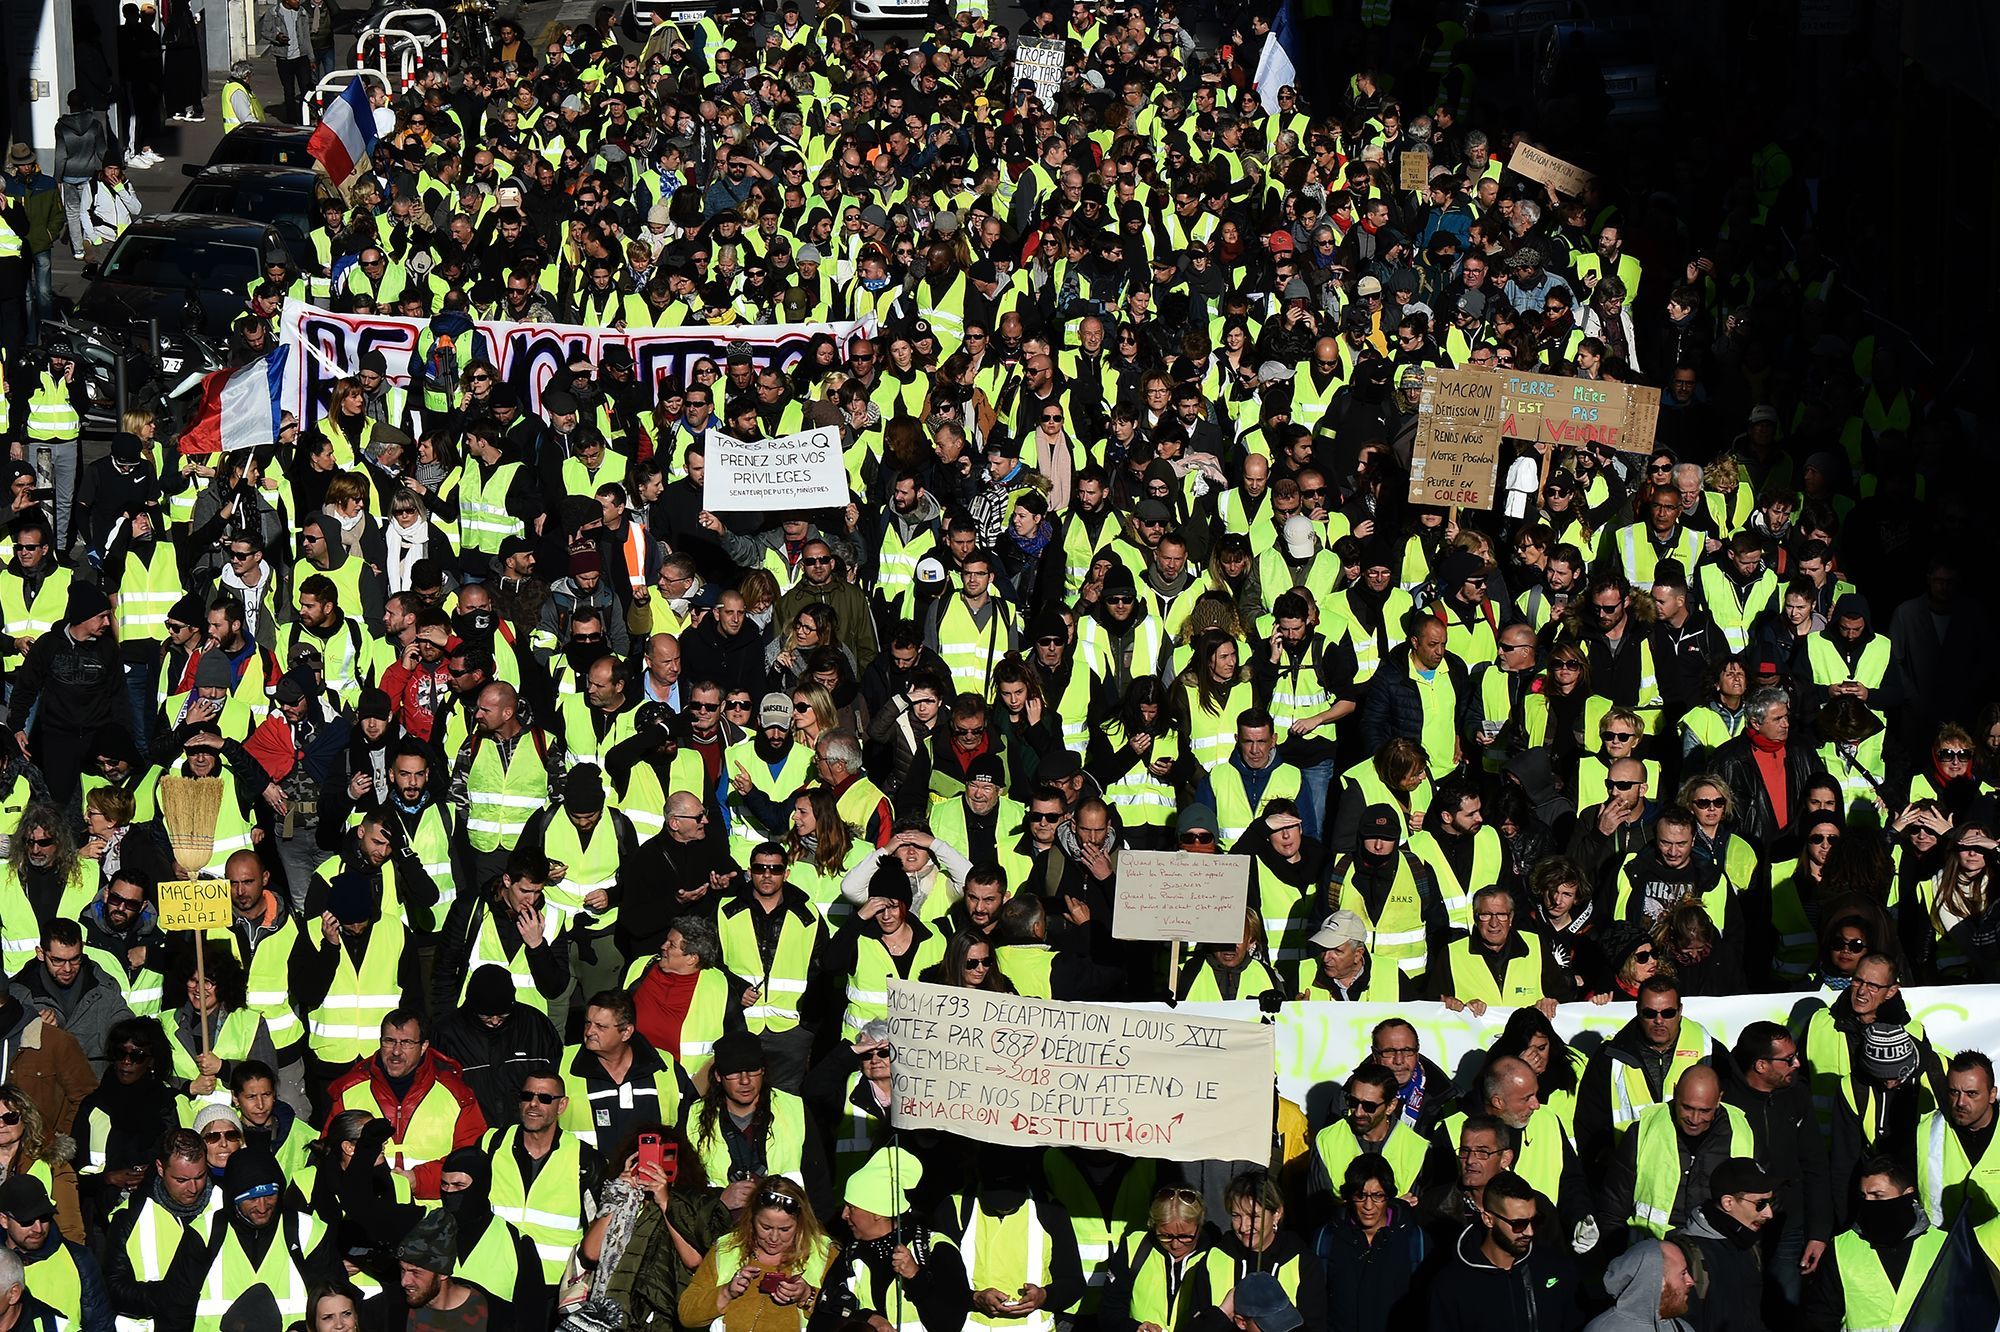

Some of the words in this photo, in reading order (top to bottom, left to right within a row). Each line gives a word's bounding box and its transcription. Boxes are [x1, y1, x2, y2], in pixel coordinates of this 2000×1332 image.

[1020, 46, 1045, 64] TROP
[1047, 50, 1063, 66] PEU
[1016, 63, 1037, 79] TROP
[1040, 66, 1062, 82] TARD
[1440, 382, 1493, 399] MACRON
[1571, 405, 1598, 421] PAS
[1433, 428, 1459, 444] RENDS
[1460, 432, 1484, 445] NOUS
[1545, 418, 1618, 445] VENDRE
[715, 436, 761, 451] TAXES
[768, 441, 795, 450] RAS
[812, 433, 830, 449] Q
[720, 453, 769, 467] PRENEZ
[775, 453, 798, 467] SUR
[800, 451, 826, 464] VOS
[1430, 450, 1458, 462] NOTRE
[1461, 453, 1494, 464] POGNON
[1426, 476, 1455, 488] PEUPLE
[1460, 480, 1474, 488] EN
[1434, 488, 1479, 503] COLÈRE
[161, 883, 228, 900] MACRON
[181, 902, 203, 912] DU
[165, 911, 216, 925] BALAI
[1122, 1017, 1175, 1043] LOUIS
[1176, 1024, 1228, 1050] XVI
[949, 1025, 984, 1048] PAR
[992, 1030, 1035, 1057] 387
[1041, 1035, 1131, 1066] DÉPUTÉS
[889, 1042, 984, 1074] DECEMBRE
[1006, 1063, 1050, 1086] 2018
[1059, 1073, 1089, 1092] ON
[1096, 1074, 1184, 1098] ATTEND
[1196, 1081, 1219, 1099] LE
[948, 1080, 971, 1101] DE
[980, 1085, 1020, 1109] NOS
[919, 1100, 999, 1126] MACRON
